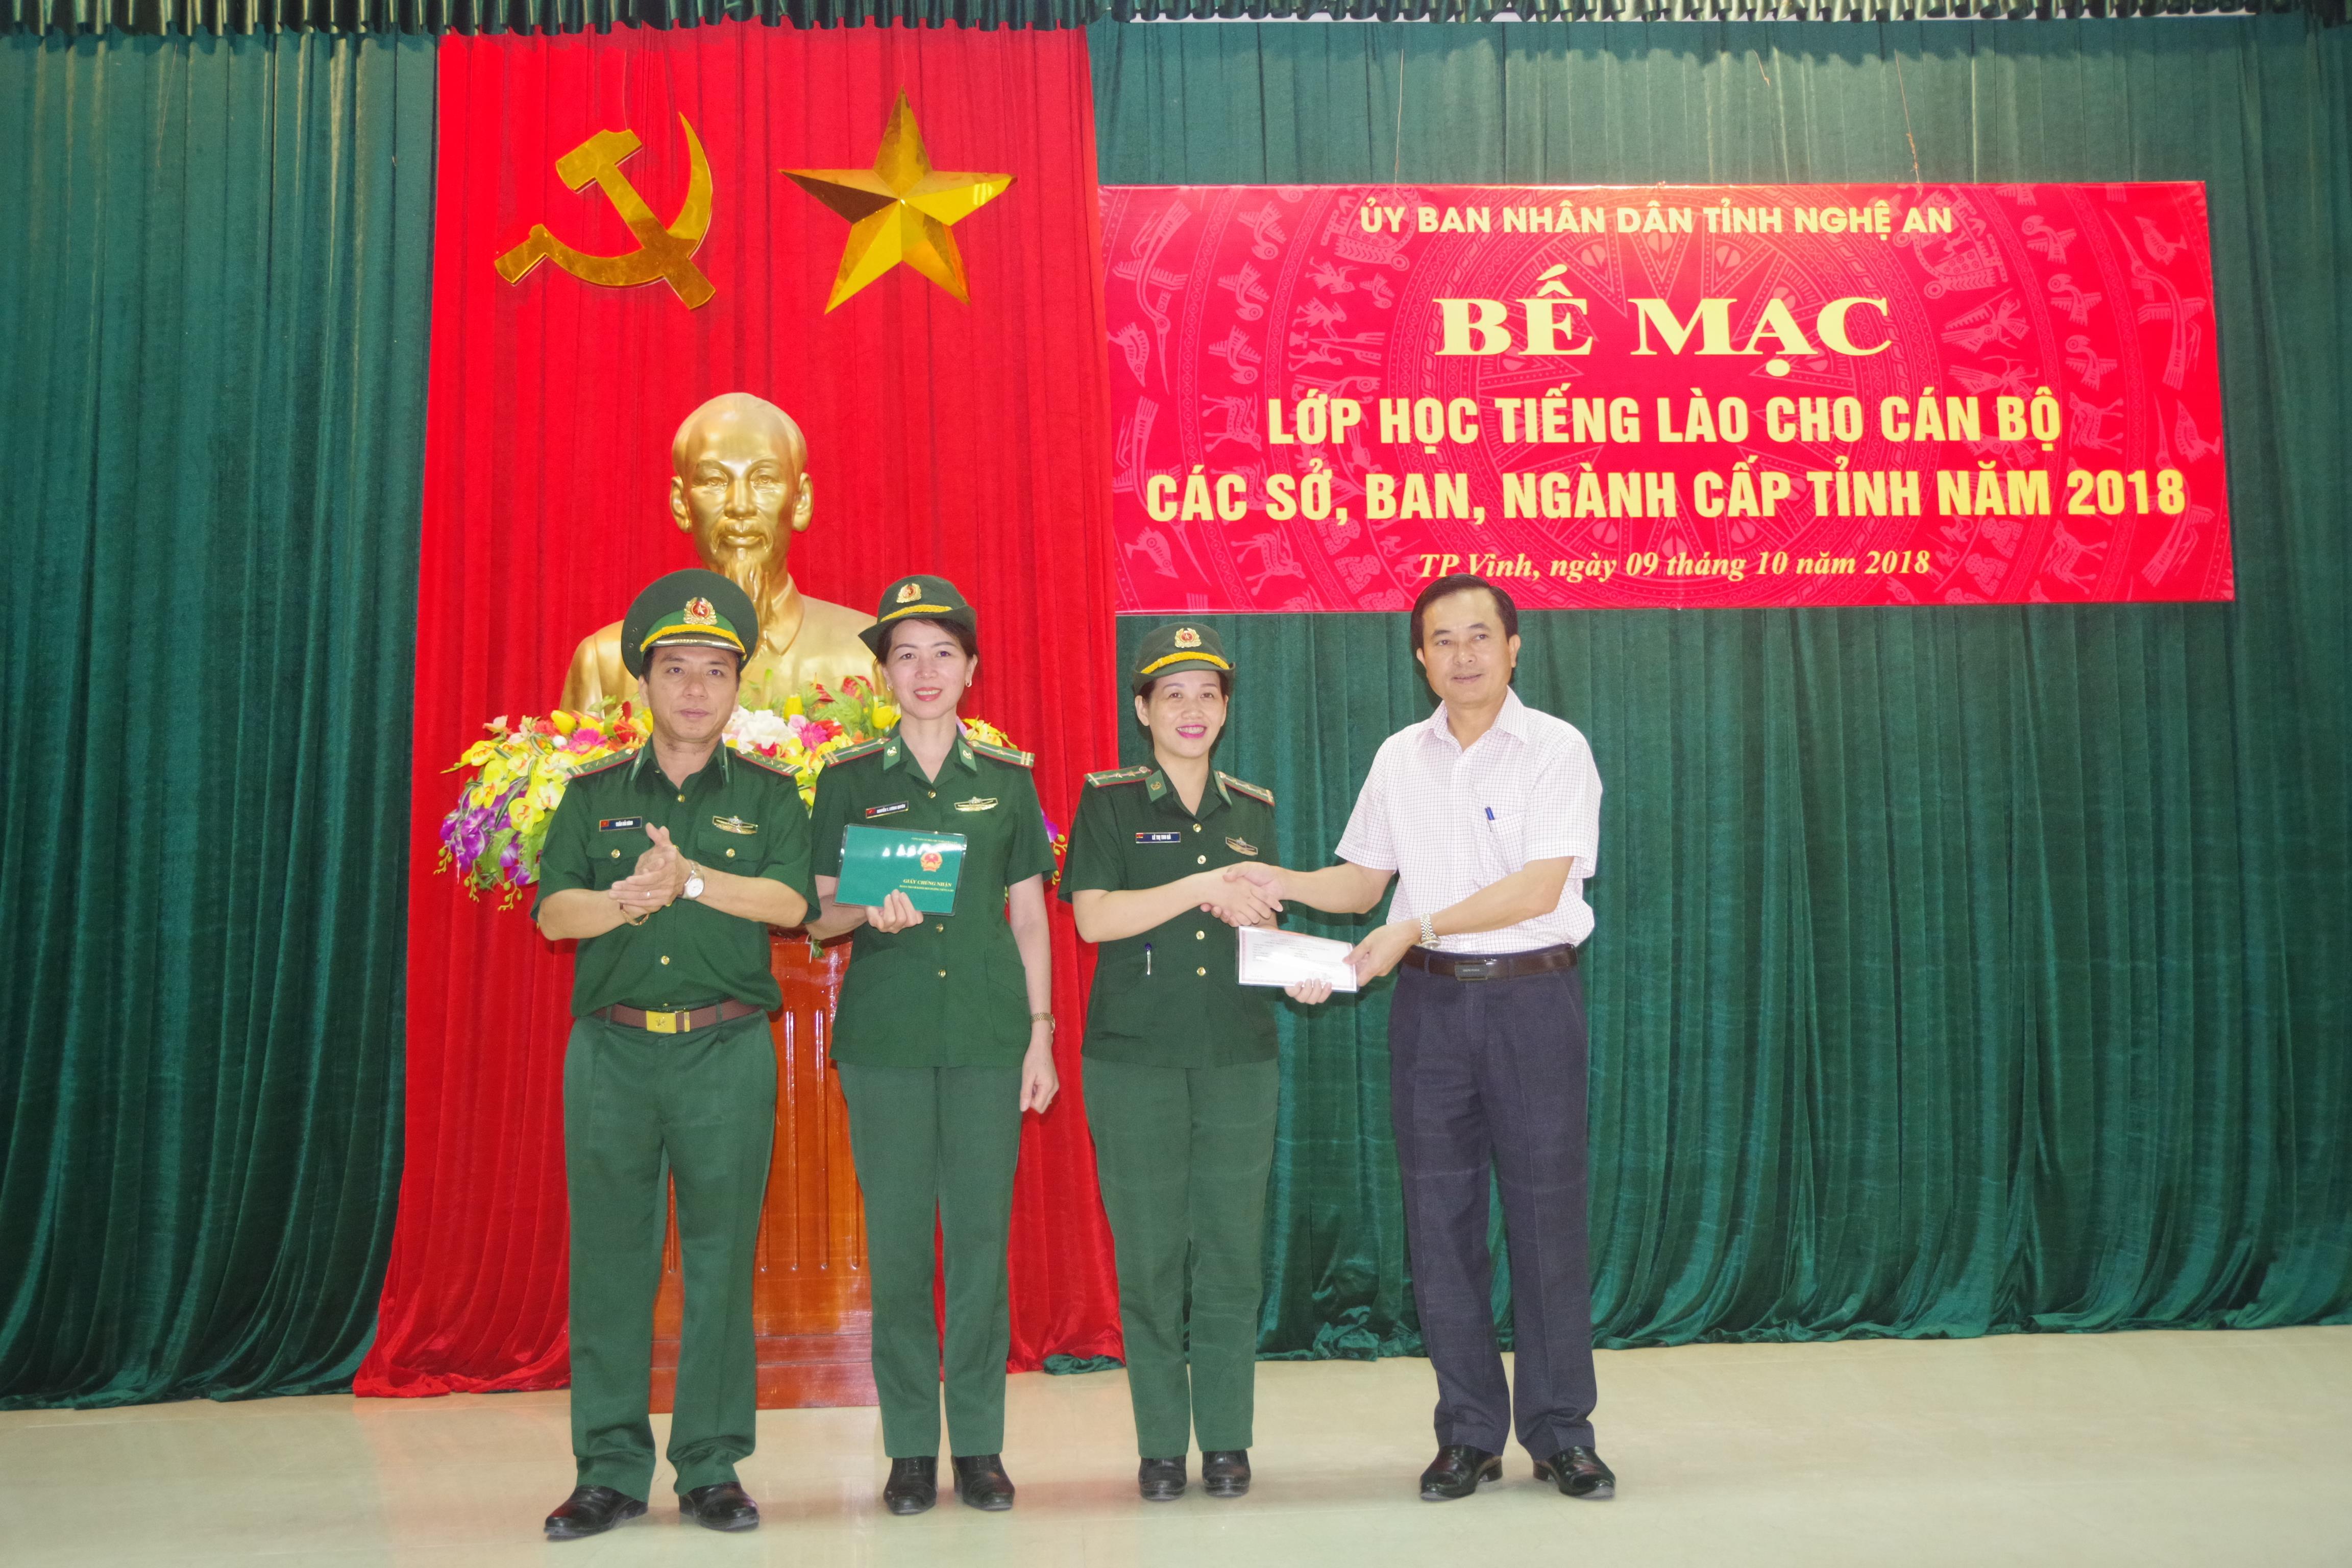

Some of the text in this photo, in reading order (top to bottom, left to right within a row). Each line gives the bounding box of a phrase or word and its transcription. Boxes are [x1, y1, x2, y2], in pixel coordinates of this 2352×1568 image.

[1360, 198, 1953, 241] ỦY BAN NHÂN DÂN TỈNH NGHỆ AN
[1432, 263, 1892, 377] BẾ MẠC
[1268, 382, 2061, 454] LỚP HỌC TIẾNG LÀO CHO CÁN BỘ
[1146, 455, 2185, 526] CÁC SỞ, BAN, NGÀNH CẤP TỈNH NĂM 2018
[1419, 550, 1930, 583] TP Vinh, ngày 09 tháng 10 năm 2018
